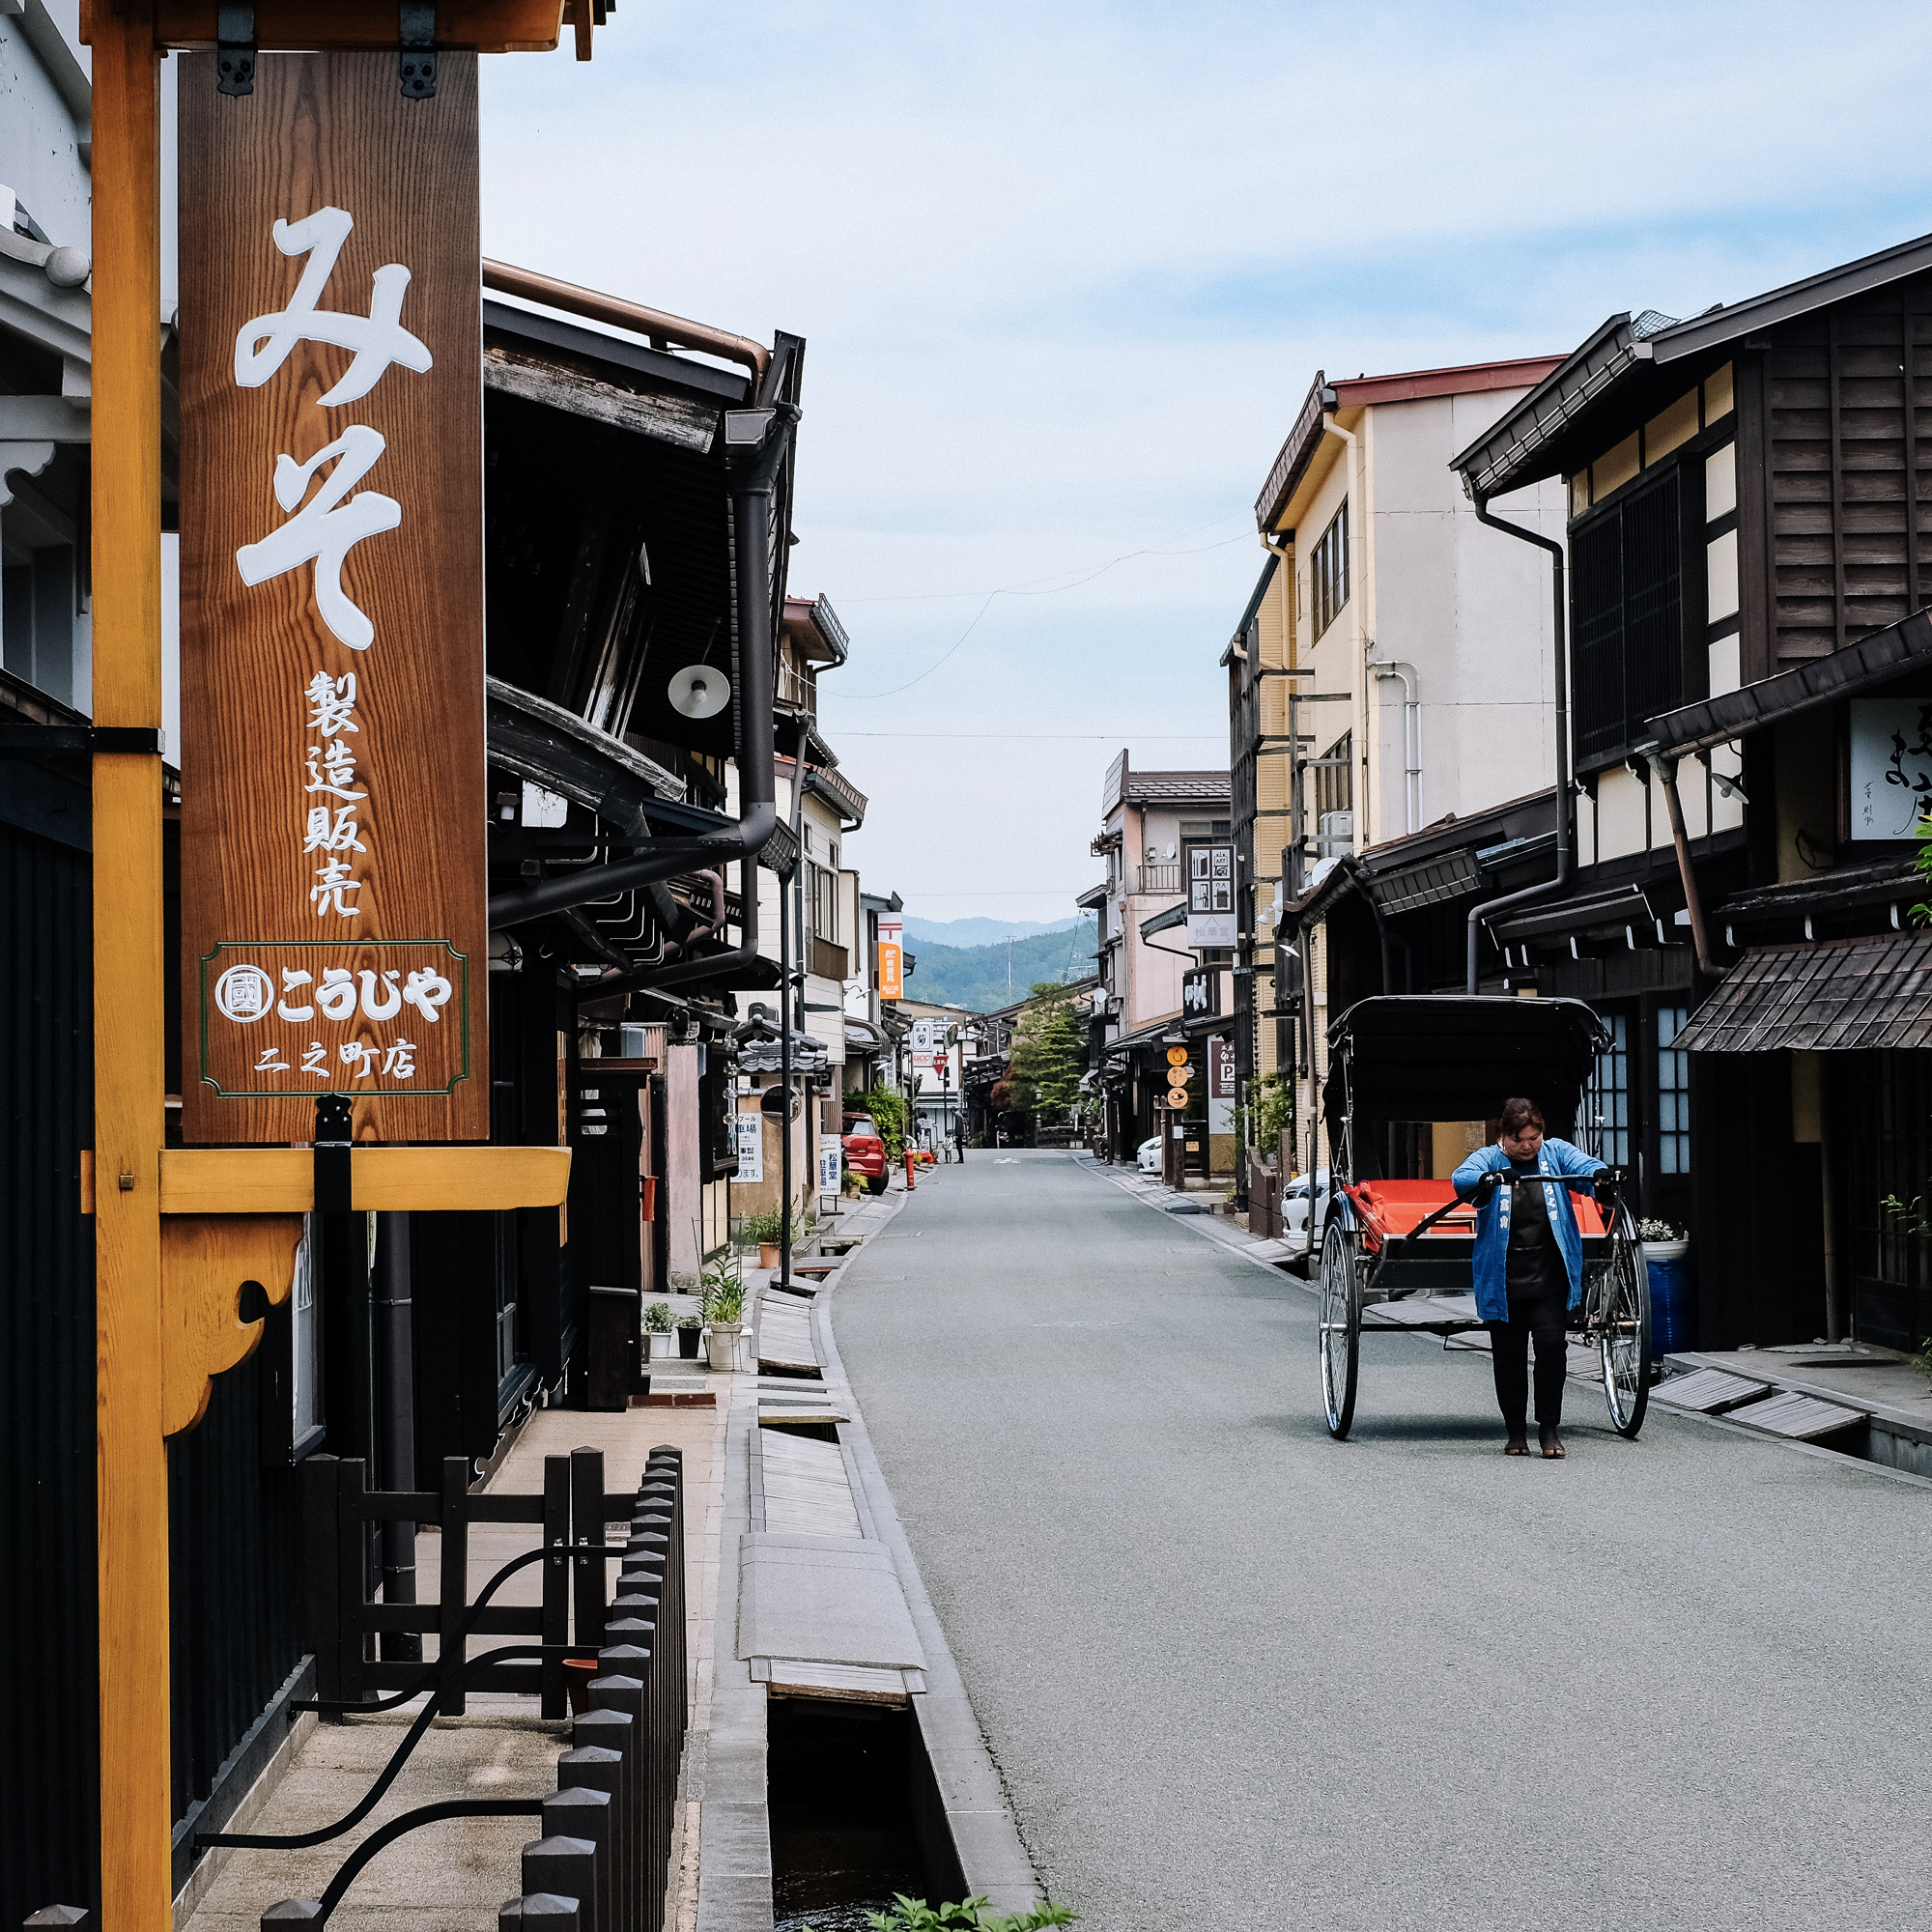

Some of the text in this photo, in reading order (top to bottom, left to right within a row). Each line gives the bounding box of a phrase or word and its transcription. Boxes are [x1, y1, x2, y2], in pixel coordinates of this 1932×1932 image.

[234, 206, 434, 651] みそ
[302, 670, 369, 918] 製造販売
[1194, 926, 1230, 937] 松華堂
[277, 966, 453, 1023] こうじや
[254, 1037, 418, 1081] 二之町店
